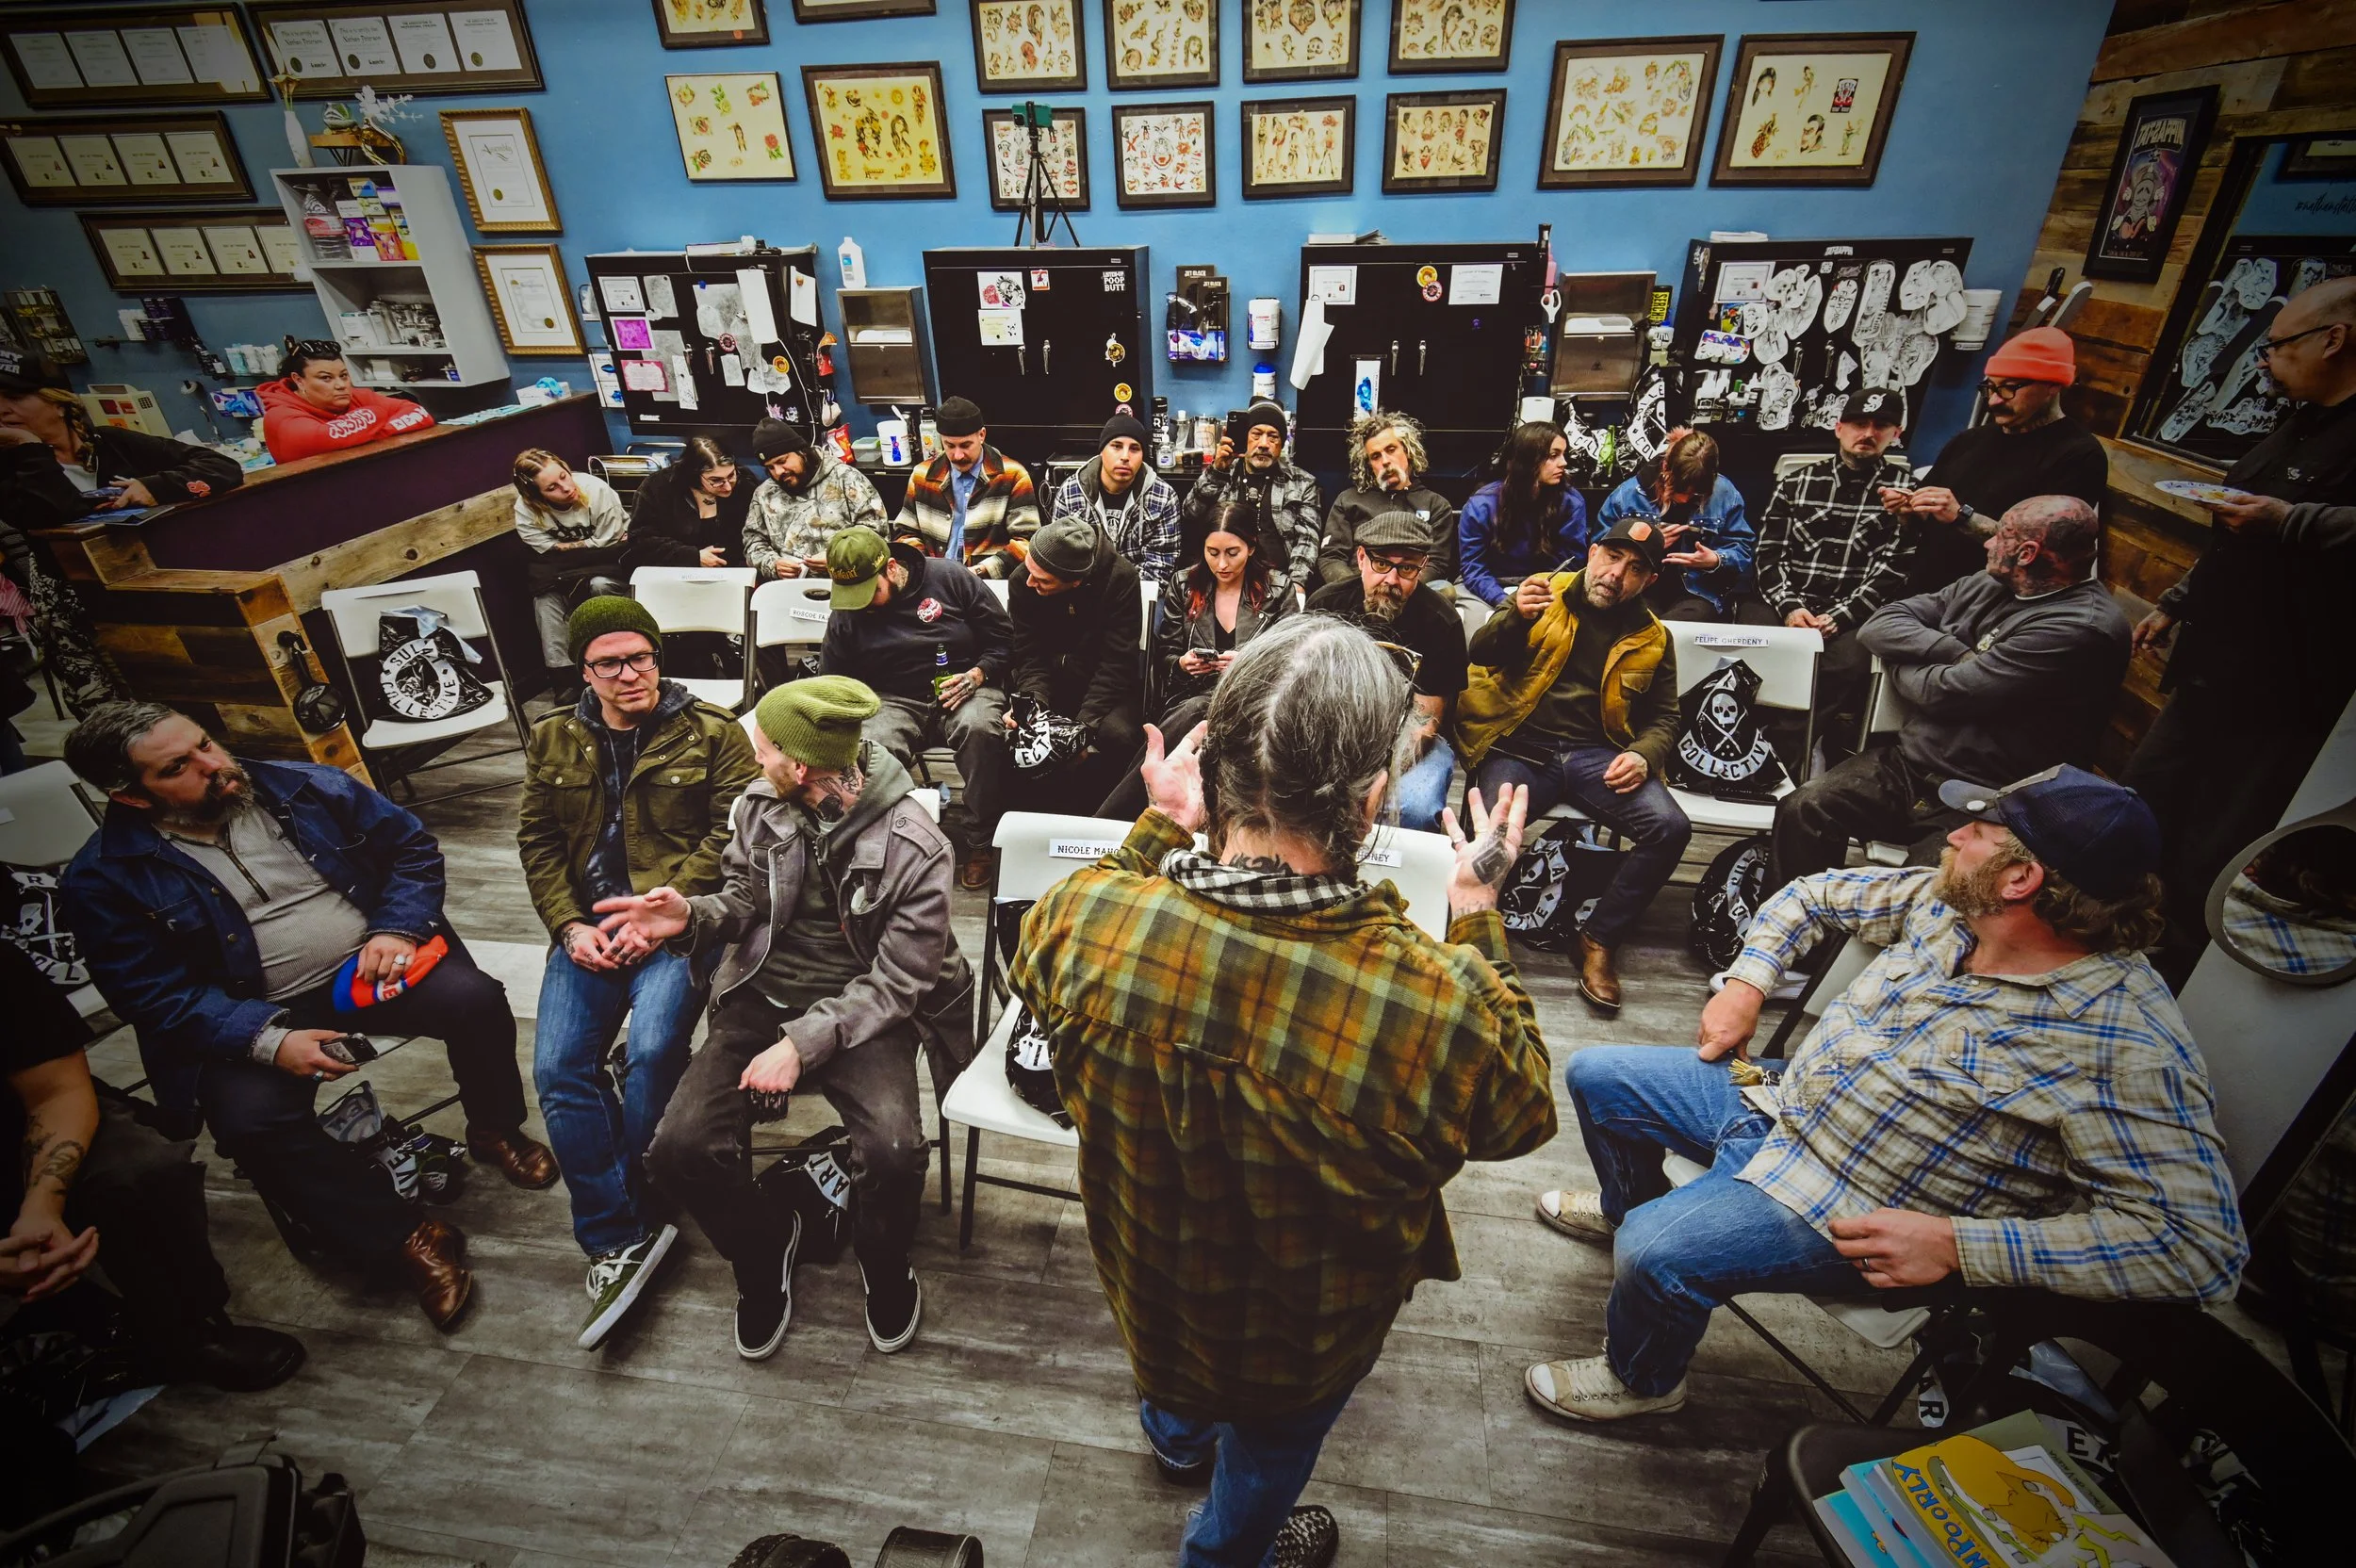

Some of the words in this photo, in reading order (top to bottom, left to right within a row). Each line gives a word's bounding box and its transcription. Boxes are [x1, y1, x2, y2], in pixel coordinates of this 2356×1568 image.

[1104, 276, 1125, 285] POOP
[1104, 284, 1125, 292] BUTT
[793, 609, 817, 619] ROSCOE
[1057, 844, 1090, 855] NICOLE
[809, 1154, 850, 1199] ART
[1893, 1462, 1977, 1560] POORLY
